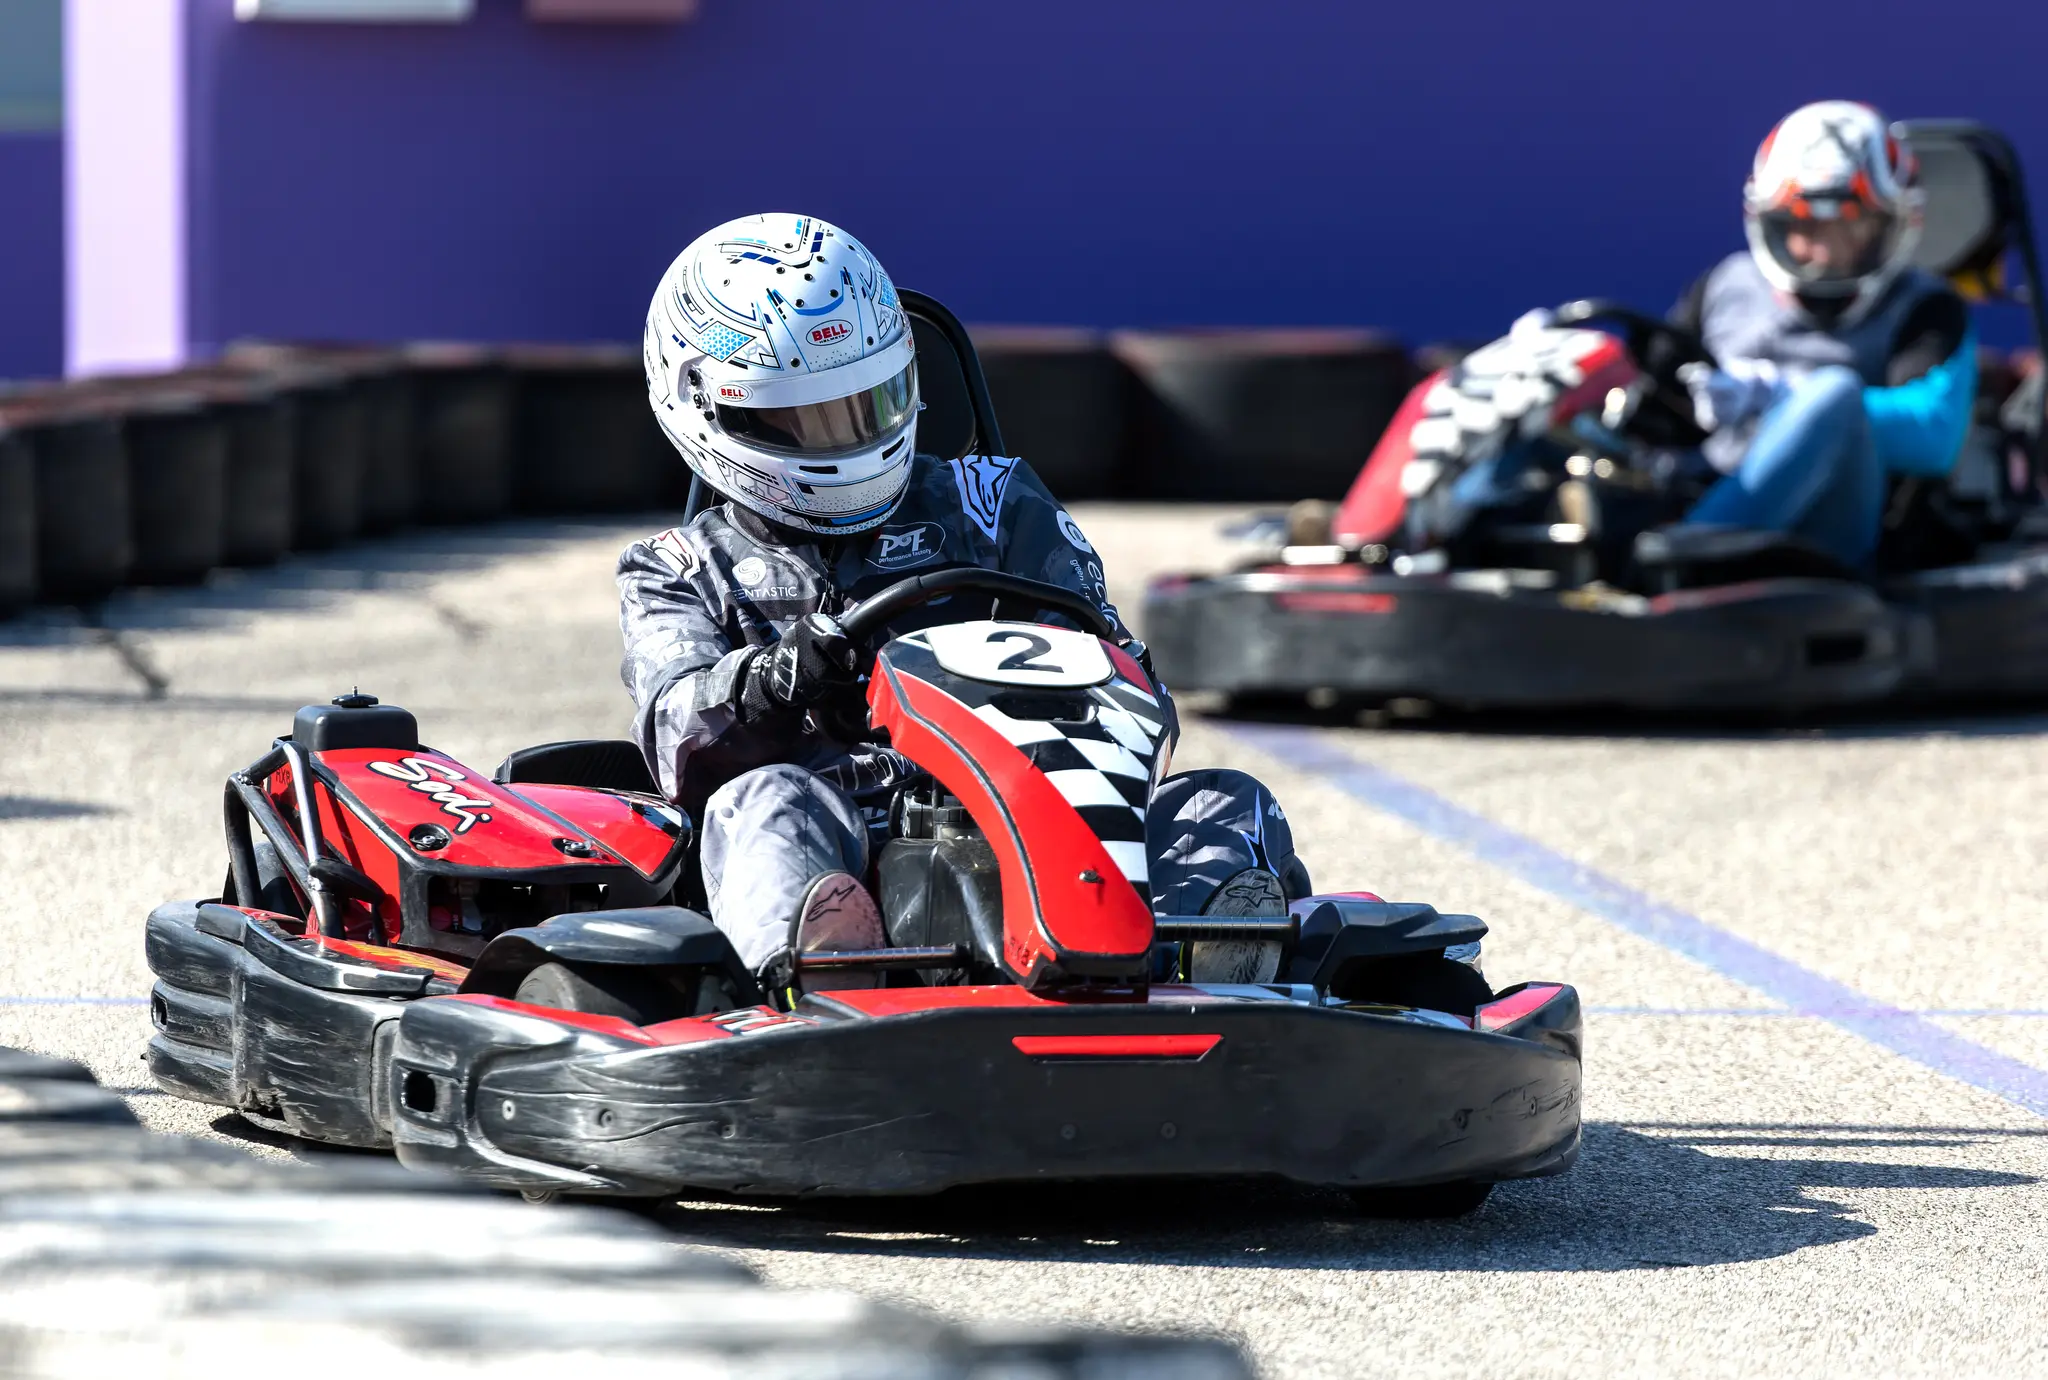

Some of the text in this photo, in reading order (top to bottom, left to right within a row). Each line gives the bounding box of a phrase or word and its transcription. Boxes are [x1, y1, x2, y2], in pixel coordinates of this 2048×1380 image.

[811, 323, 849, 342] BELL
[720, 387, 745, 398] BELL
[878, 552, 912, 564] performance
[912, 547, 932, 558] factory
[1069, 559, 1084, 582] green
[985, 630, 1065, 674] 2
[365, 756, 495, 836] Sodi
